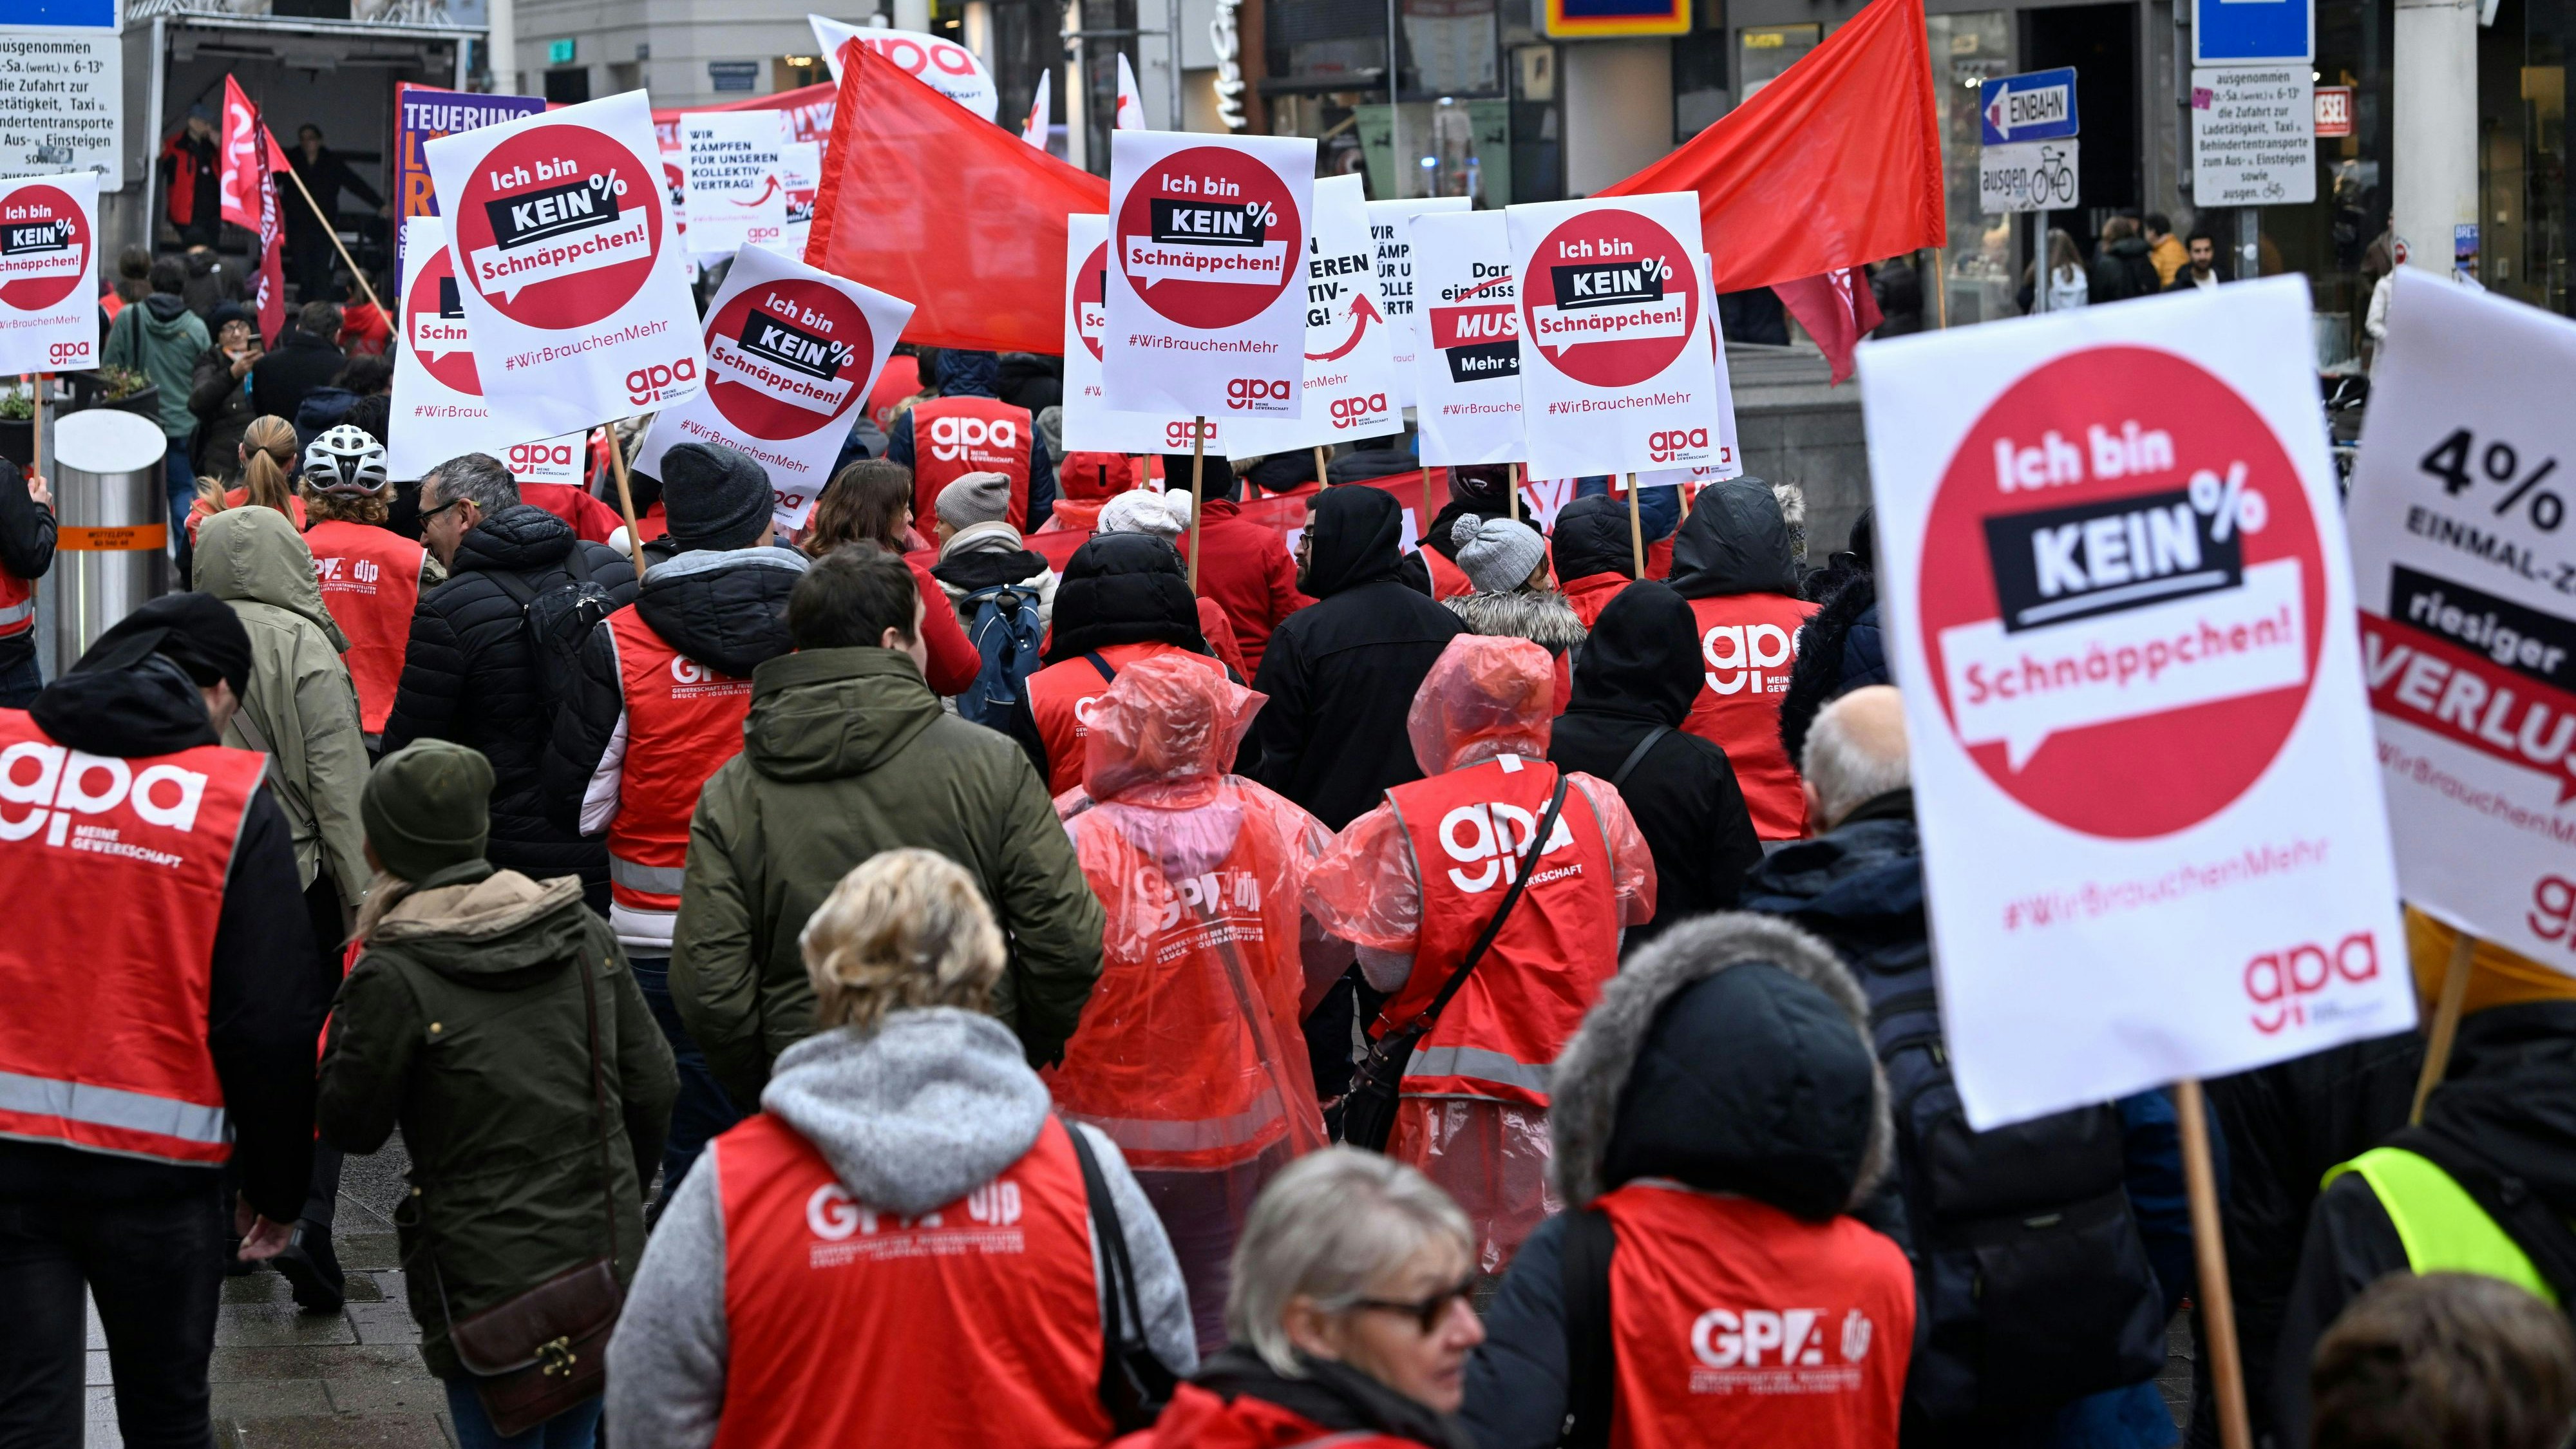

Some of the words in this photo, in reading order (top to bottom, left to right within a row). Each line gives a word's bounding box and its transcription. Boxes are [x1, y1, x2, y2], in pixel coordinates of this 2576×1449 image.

[26, 62, 61, 73] (werkt.)
[19, 79, 66, 92] Zufahrt
[70, 82, 89, 92] zur
[2217, 71, 2291, 86] ausgenommen
[0, 97, 62, 113] etätigkeit,
[70, 98, 95, 111] Taxi
[2011, 90, 2063, 123] EINBAHN
[2218, 107, 2232, 118] die
[2236, 106, 2271, 118] Zufahrt
[2274, 107, 2289, 116] zur
[0, 116, 113, 133] ndertentransporte
[690, 131, 714, 139] WIR
[2202, 122, 2269, 136] Ladetätigkeit,
[2275, 120, 2294, 133] Taxi
[5, 134, 31, 146] Aus-
[47, 134, 111, 149] Einsteigen
[690, 140, 752, 152] KÄMPFEN
[2200, 138, 2308, 152] Behindertentransporte
[692, 153, 715, 165] FÜR
[720, 153, 778, 164] UNSEREN
[2202, 157, 2222, 167] zum
[2257, 153, 2306, 167] Einsteigen
[490, 166, 531, 191] Ich
[536, 157, 578, 181] bin
[692, 166, 765, 177] KOLLEKTIV-
[1983, 167, 2031, 196] ausgen.
[2241, 169, 2268, 182] sowie
[693, 179, 753, 191] VERTRAG!
[1162, 173, 1197, 193] Ich
[1204, 176, 1240, 196] bin
[6, 206, 26, 220] Ich
[30, 205, 52, 218] bin
[748, 227, 779, 243] gpa
[482, 224, 645, 279] Schnäppchen!
[1559, 239, 1593, 259] Ich
[1598, 238, 1633, 256] bin
[0, 255, 79, 273] chnäppchen!
[1132, 247, 1280, 273] Schnäppchen!
[1309, 253, 1369, 279] EREN
[1472, 262, 1511, 278] Dar
[1478, 283, 1514, 299] biss
[0, 315, 81, 330] WirBrauchenMehr
[764, 292, 797, 318] Ich
[800, 307, 834, 334] bin
[1540, 307, 1682, 334] Schnäppchen!
[1455, 312, 1519, 338] MUS
[50, 341, 90, 365] gpa
[505, 319, 668, 371] #WirBrauchenMehr
[1129, 334, 1279, 354] #WirBrauchenMehr
[1461, 355, 1505, 372] Mehr
[625, 357, 697, 406] gpa
[712, 346, 843, 406] Schnäppchen!
[663, 386, 697, 400] GEWERKSCHAFT
[1227, 378, 1291, 410] gpa
[1548, 392, 1691, 415] #WirBrauchenMehr
[414, 405, 489, 418] #WirBrauc
[1331, 392, 1388, 429] gpa
[1443, 401, 1522, 415] #WirBrauche
[1358, 417, 1388, 426] GEWERKSCHAFT
[931, 416, 1016, 462] gpa
[1649, 428, 1709, 462] gpa
[509, 444, 572, 474] gpa
[970, 456, 1014, 464] GEWERKSCHAFT
[1993, 430, 2081, 494] Ich
[2087, 419, 2175, 478] bin
[2418, 427, 2564, 533] 4%
[2405, 504, 2576, 597] EINMAL-Z
[354, 559, 379, 583] djp
[2408, 591, 2567, 674] riesiger
[1703, 623, 1804, 695] gp
[1964, 605, 2295, 705] Schnäppchen!
[672, 685, 720, 694] GEWERKSCHAFT
[708, 688, 752, 697] JOURNALIS
[0, 741, 209, 848] gpa
[75, 825, 120, 842] MEINE
[71, 837, 182, 868] GEWERKSCHAFT
[1439, 799, 1575, 894] gpa
[1524, 864, 1582, 888] RKSCHAFT
[2244, 931, 2381, 1034] gpa
